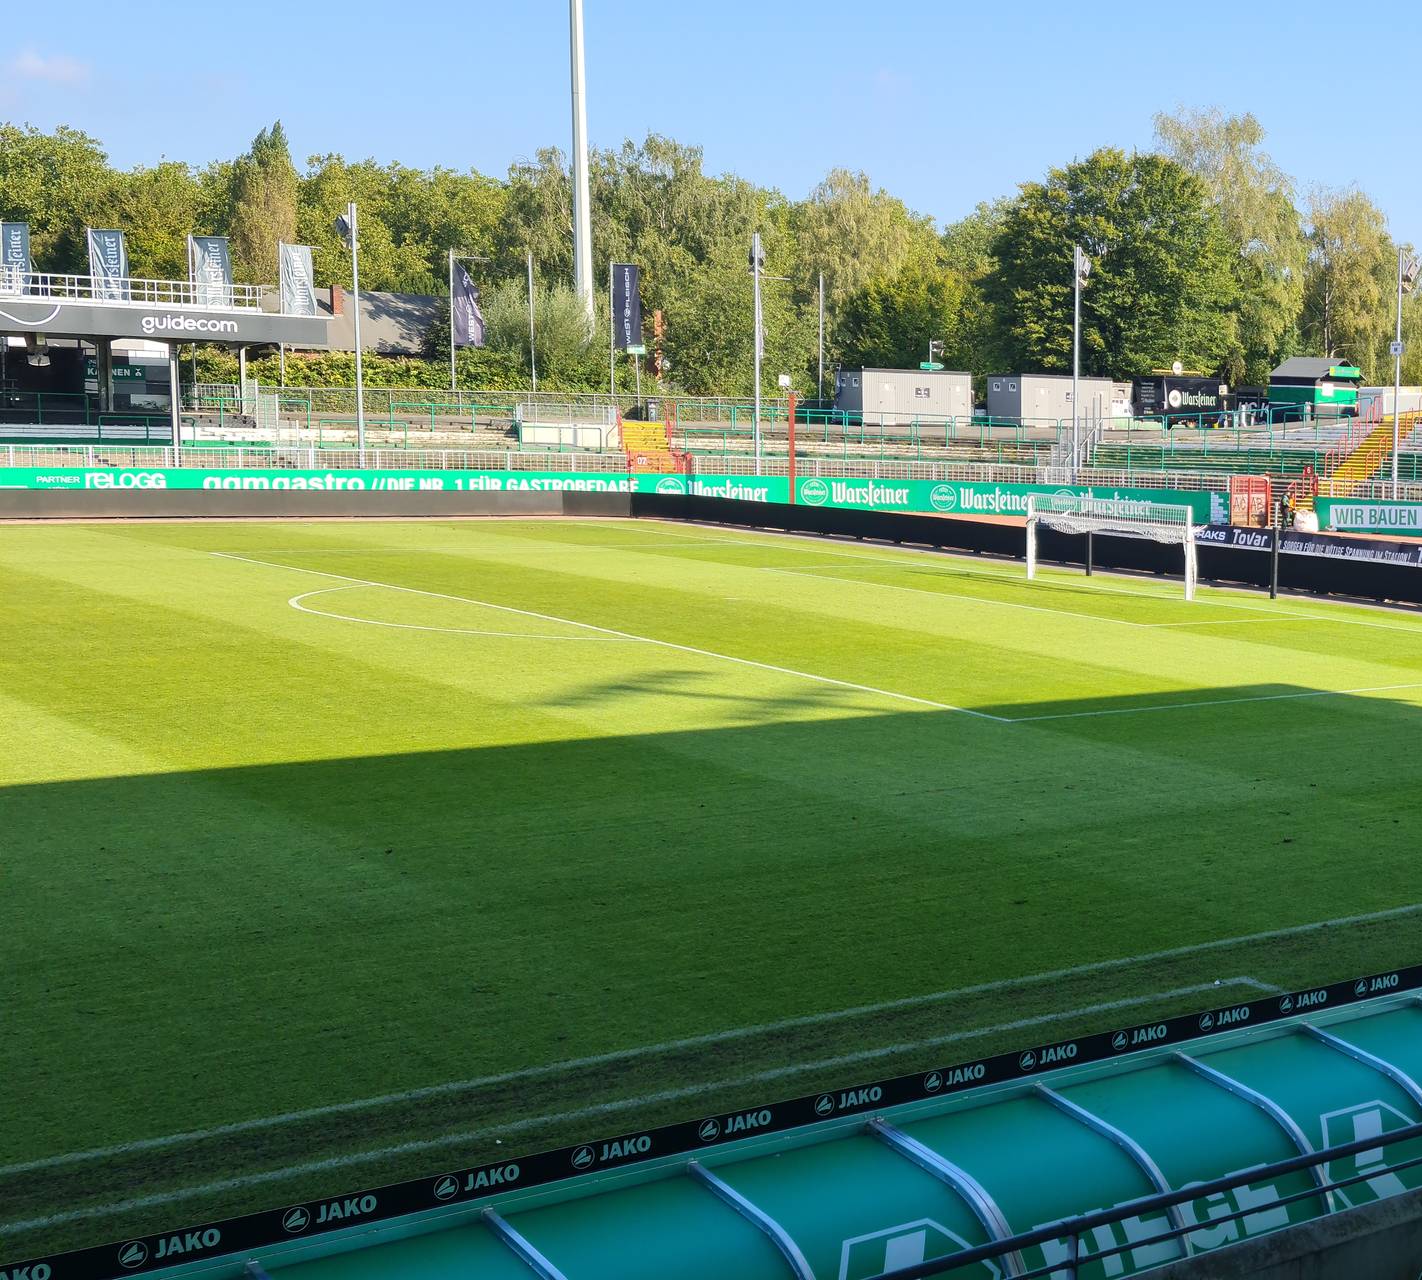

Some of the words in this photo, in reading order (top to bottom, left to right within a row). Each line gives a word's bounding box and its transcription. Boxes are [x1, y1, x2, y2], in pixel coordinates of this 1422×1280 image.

[141, 314, 238, 334] guidecom
[1181, 391, 1217, 408] Warsteiner
[36, 475, 80, 484] PARTNER
[831, 480, 910, 507] Warsteiner
[1334, 507, 1364, 525] WIR
[1368, 508, 1418, 526] BAUEN
[1232, 528, 1269, 548] Tovar
[1368, 973, 1399, 992] JAKO
[1295, 989, 1327, 1009] JAKO
[1216, 1005, 1250, 1026] JAKO
[1130, 1023, 1168, 1045] JAKO
[1039, 1043, 1078, 1065] JAKO
[945, 1063, 985, 1086] JAKO
[838, 1086, 882, 1110] JAKO
[723, 1109, 772, 1135] JAKO
[599, 1135, 652, 1162] JAKO
[463, 1163, 520, 1192] JAKO
[316, 1194, 377, 1225] JAKO
[154, 1228, 221, 1260] JAKO
[0, 1263, 52, 1280] AKO
